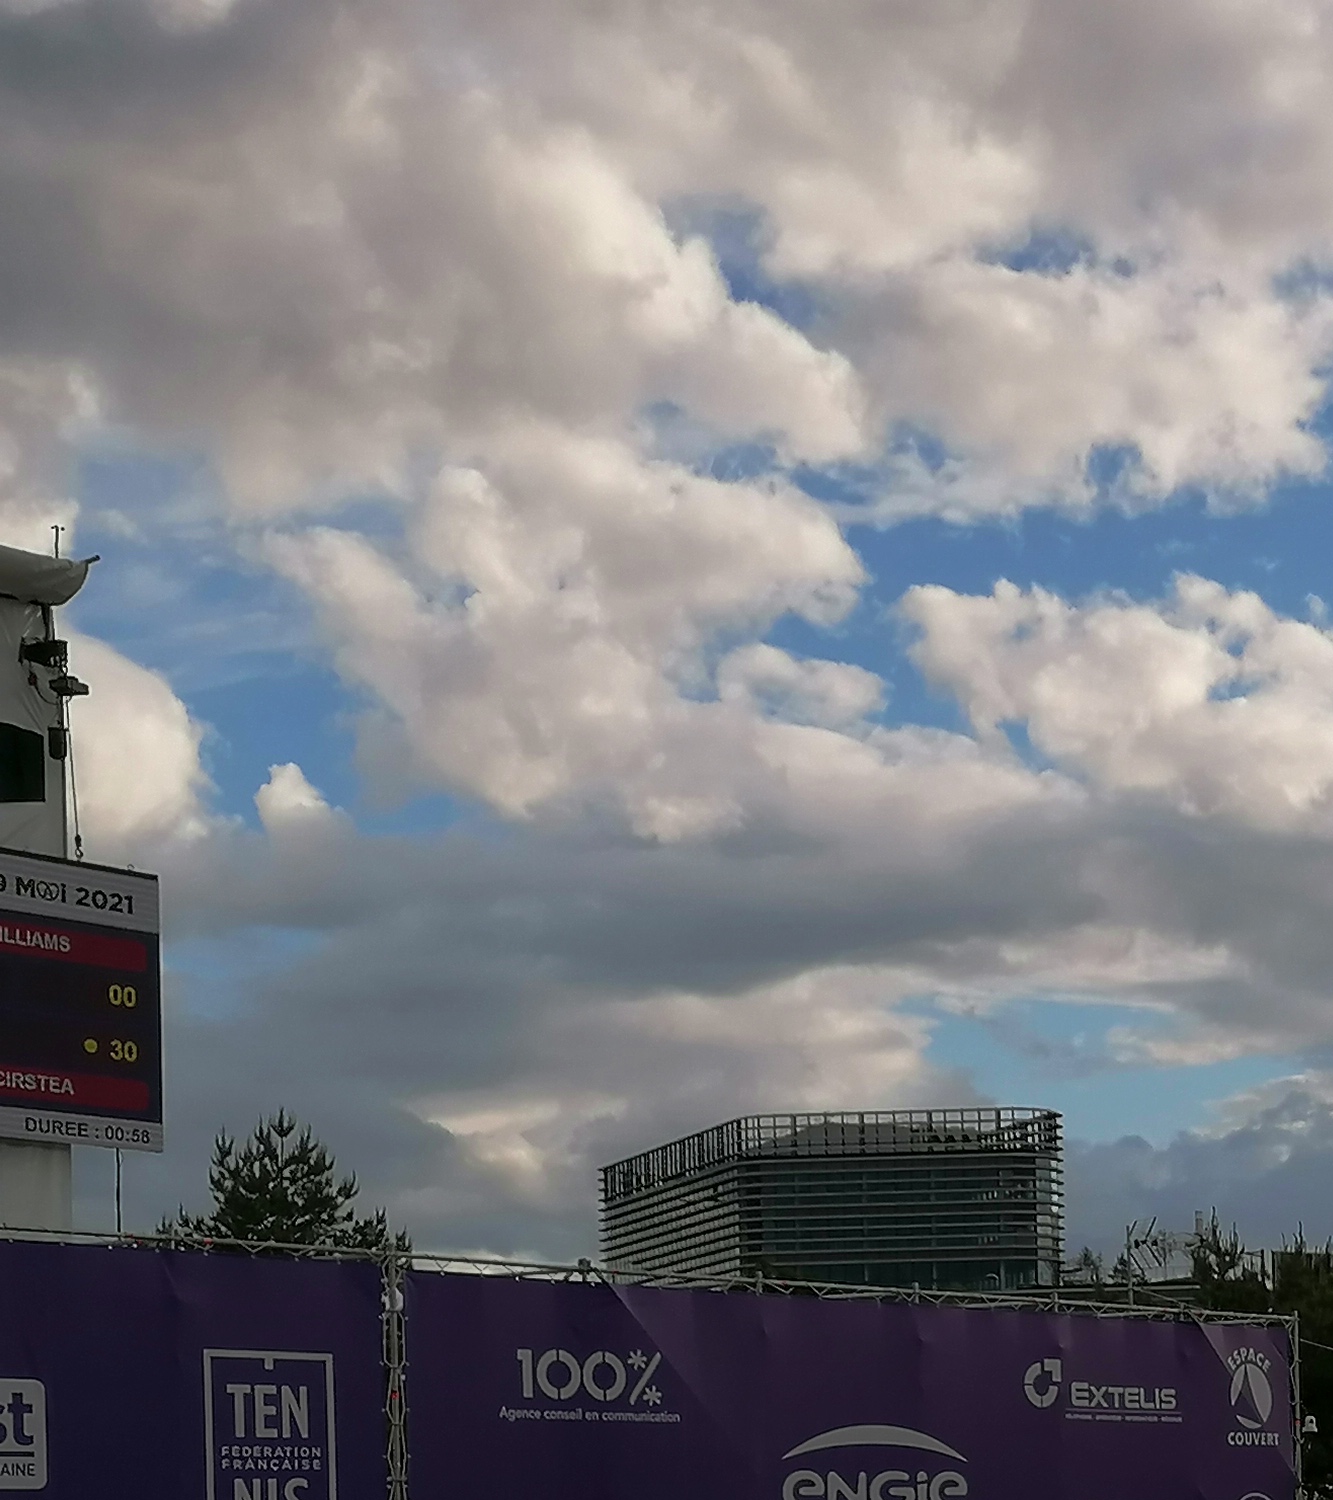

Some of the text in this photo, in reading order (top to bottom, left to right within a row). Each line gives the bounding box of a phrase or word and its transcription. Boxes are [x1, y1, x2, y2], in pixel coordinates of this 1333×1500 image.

[76, 887, 134, 914] 2021
[108, 984, 137, 1008] 00
[110, 1039, 138, 1062] 30
[105, 1125, 150, 1144] 00:58
[1227, 1347, 1272, 1373] ESPACE
[226, 1383, 309, 1439] TEN
[499, 1406, 681, 1424] Agence conseil en communication
[1227, 1432, 1279, 1446] COUVERT
